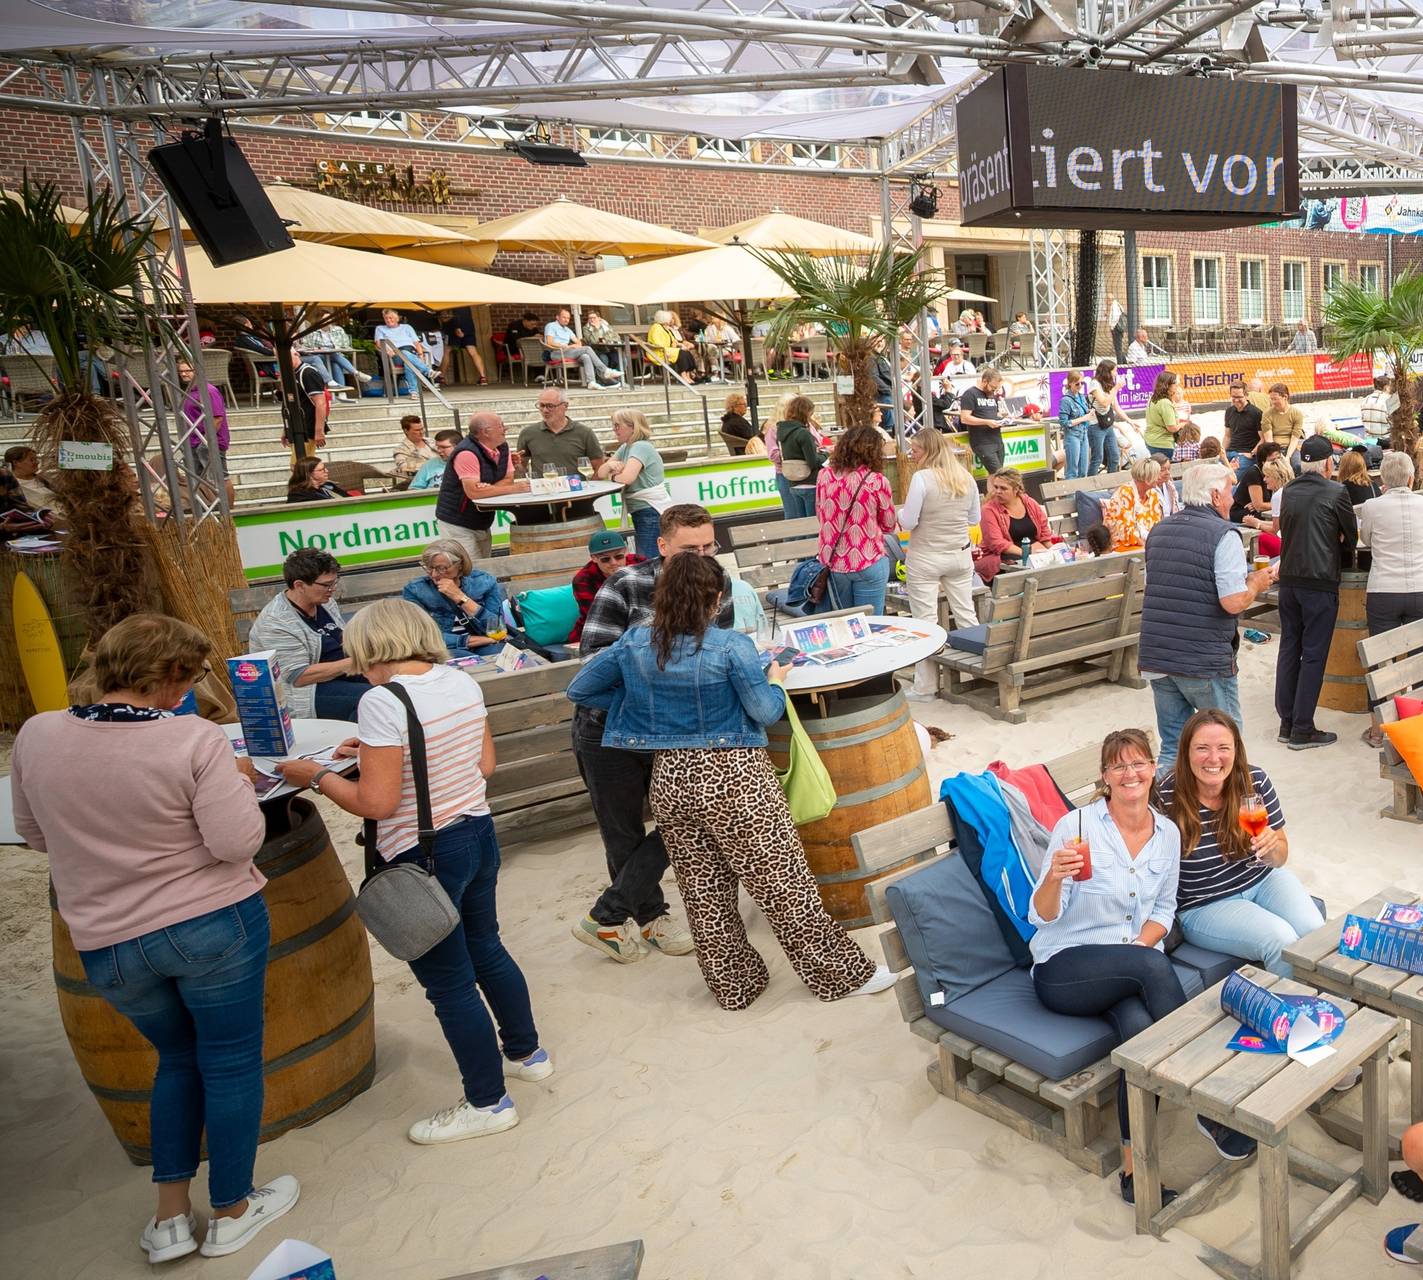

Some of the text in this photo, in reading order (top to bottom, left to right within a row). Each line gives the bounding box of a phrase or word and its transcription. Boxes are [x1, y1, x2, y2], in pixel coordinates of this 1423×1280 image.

[1183, 371, 1246, 388] hölscher
[75, 452, 112, 461] moubis
[697, 474, 780, 502] Hoffma
[278, 516, 440, 556] Nordman
